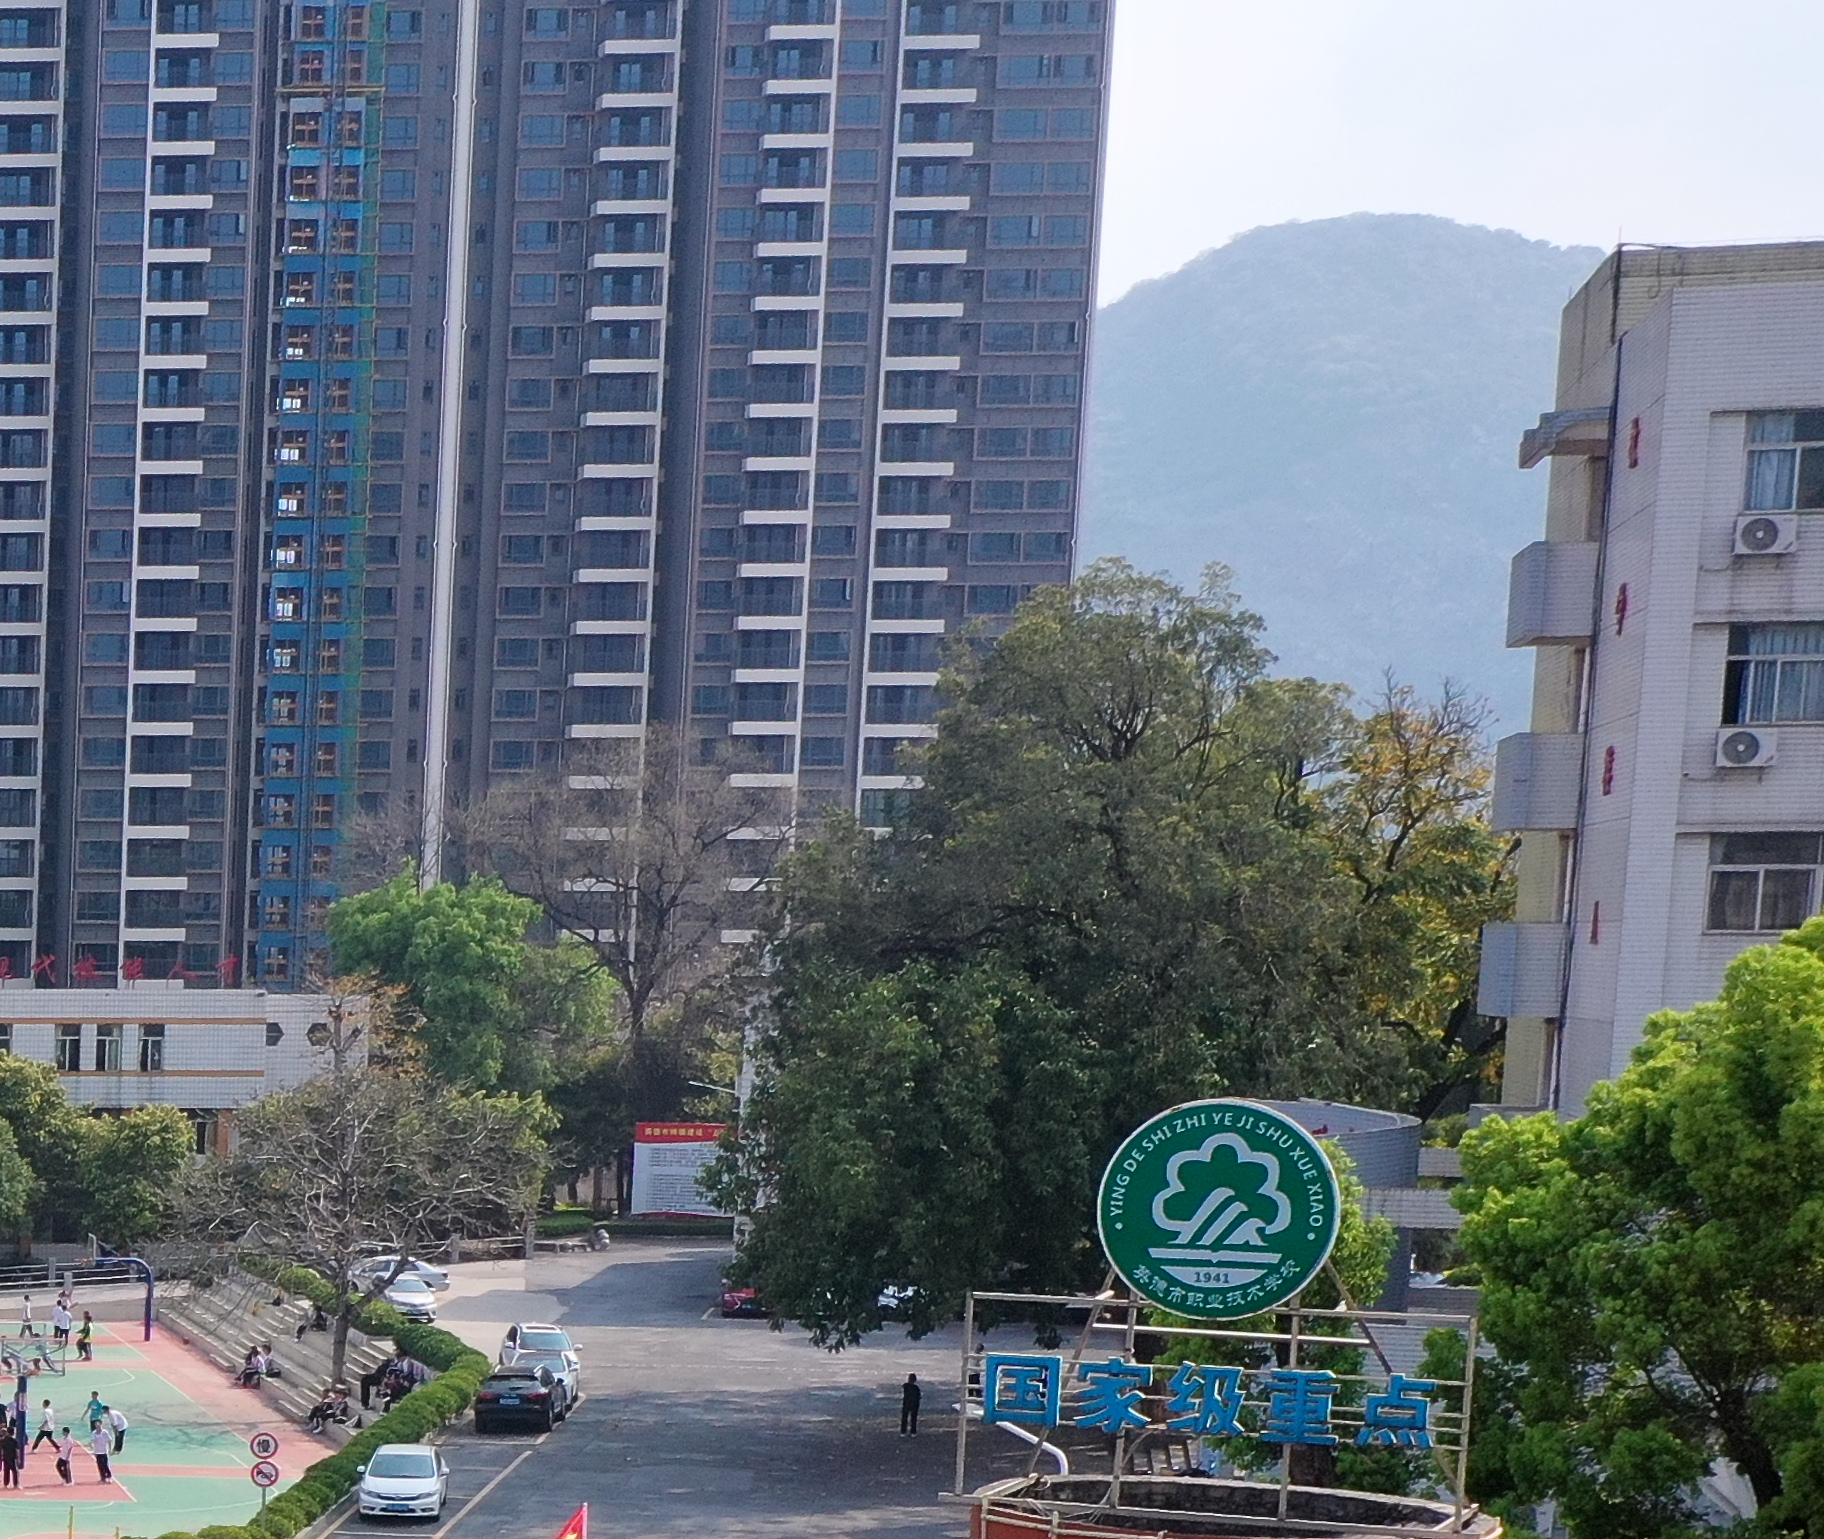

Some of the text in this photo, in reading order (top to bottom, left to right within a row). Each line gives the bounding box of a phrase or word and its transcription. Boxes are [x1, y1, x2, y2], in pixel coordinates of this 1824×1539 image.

[1110, 1112, 1324, 1227] YING DE SHI ZHI YE JI SHU XUE XIAO
[1132, 1259, 1301, 1310] 英德市职业技术学校
[1193, 1272, 1230, 1284] 1941
[983, 1352, 1436, 1449] 国家级重点
